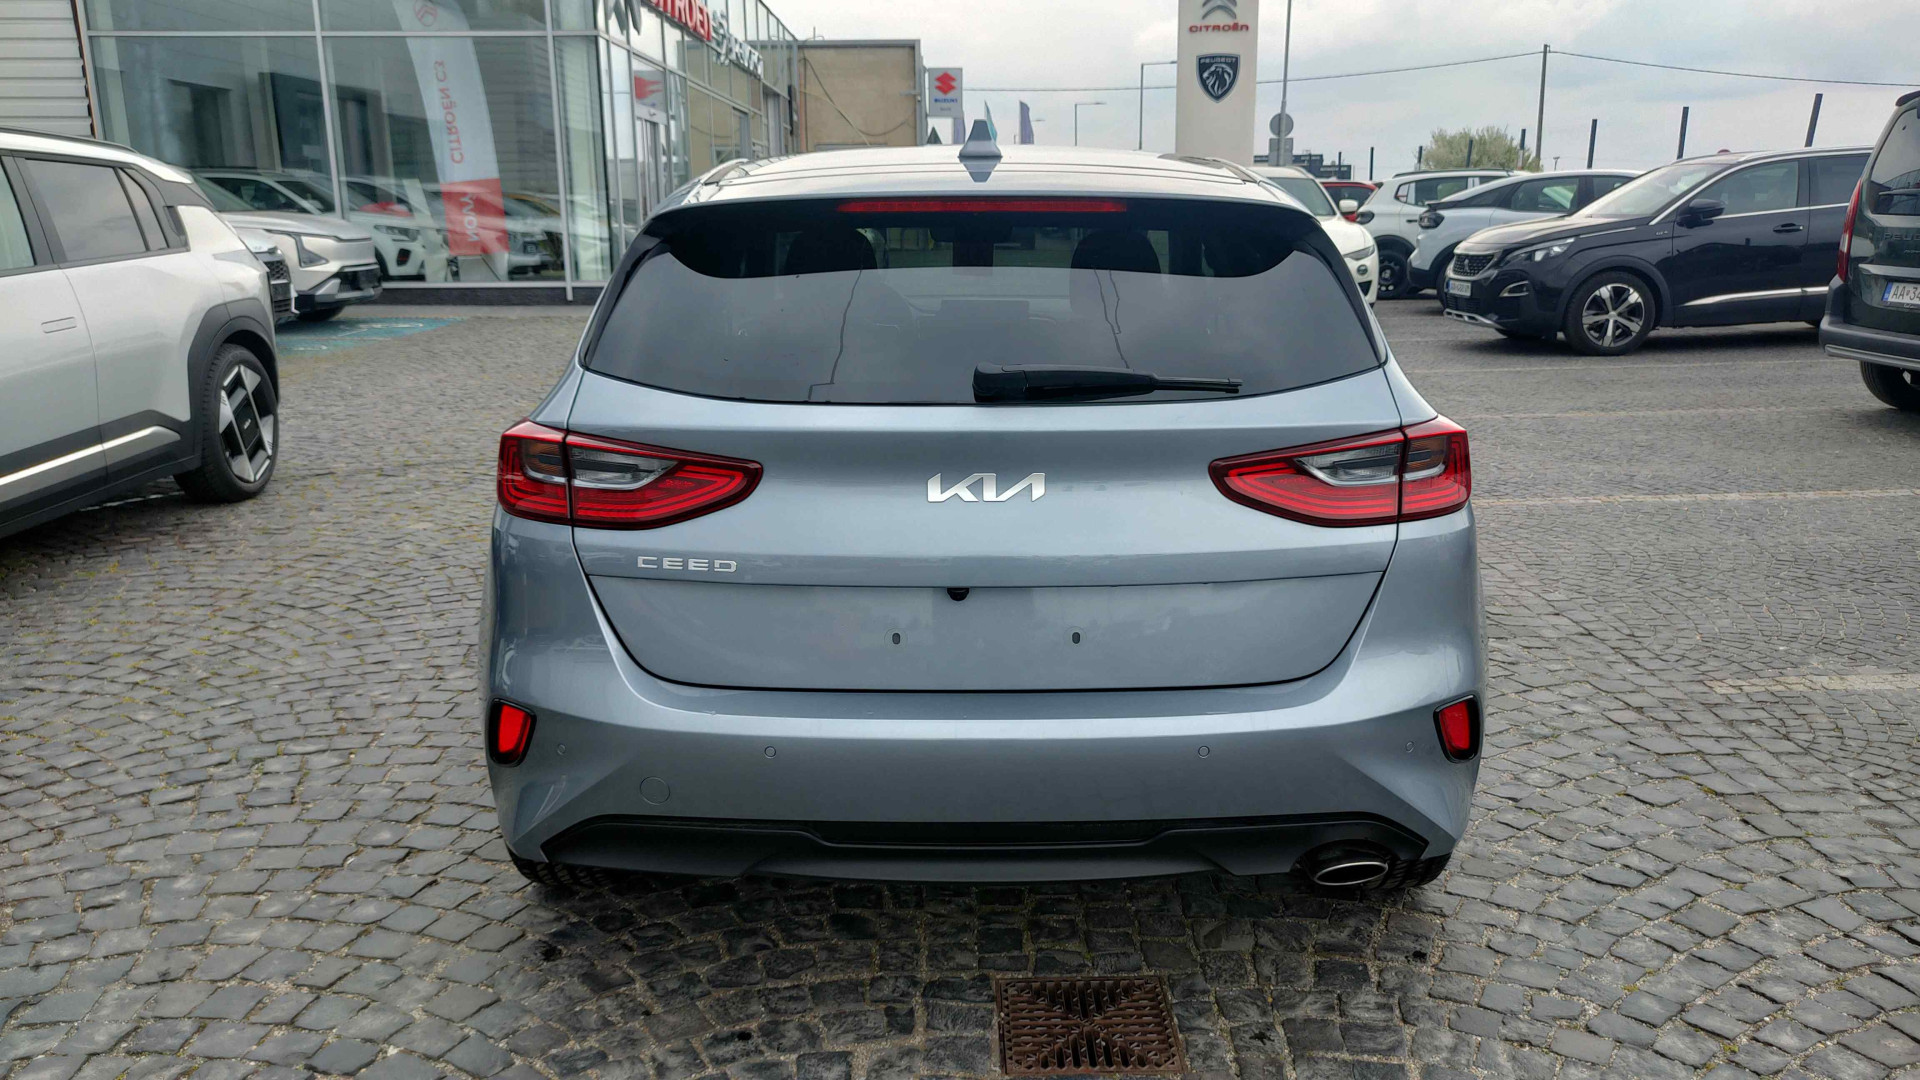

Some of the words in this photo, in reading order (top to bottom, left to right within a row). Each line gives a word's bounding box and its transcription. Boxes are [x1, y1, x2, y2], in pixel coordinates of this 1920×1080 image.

[1188, 22, 1250, 33] CITROËN
[927, 472, 1046, 503] KIA
[637, 556, 738, 573] CEED
